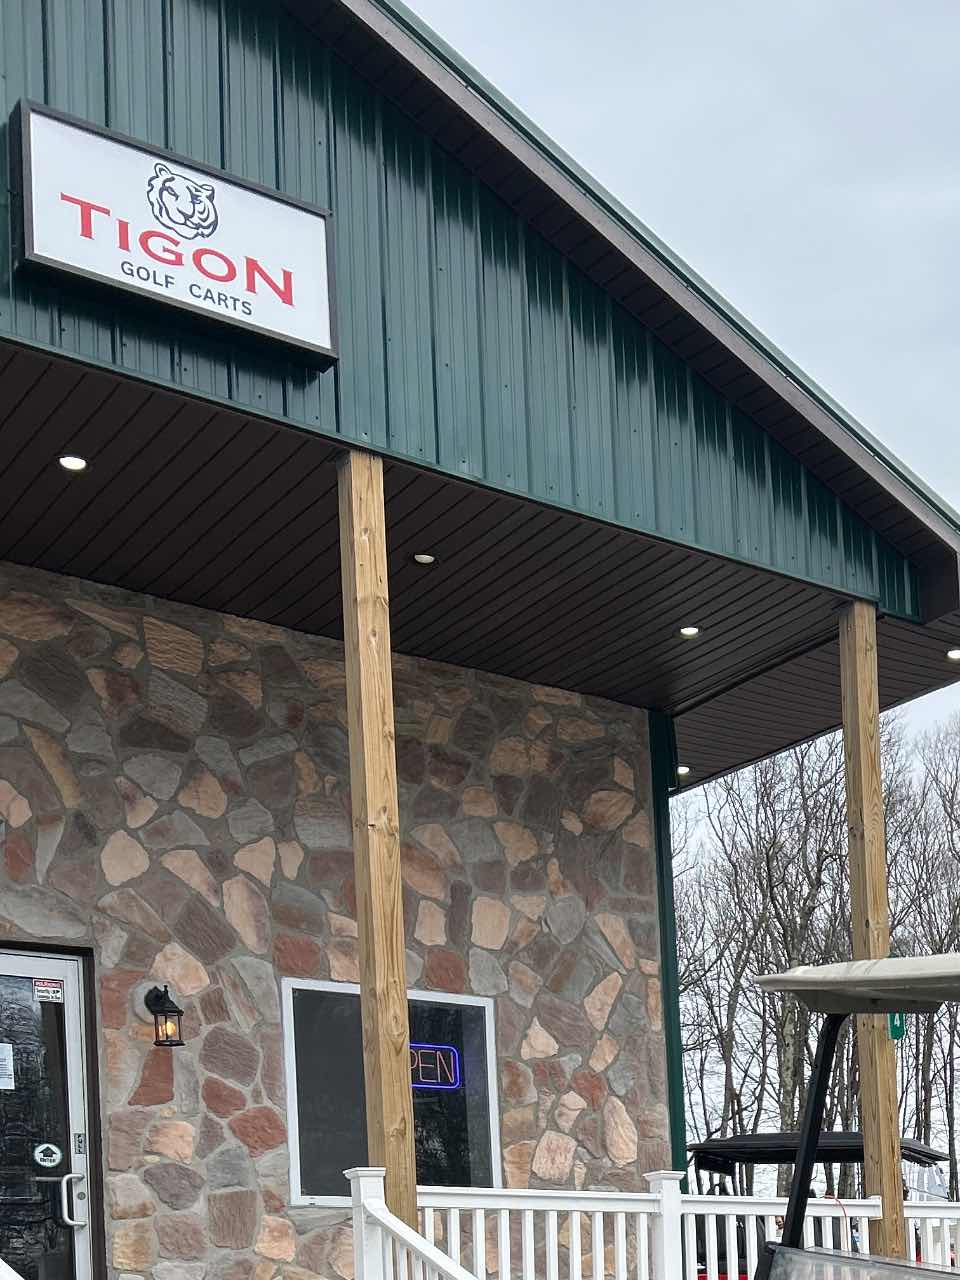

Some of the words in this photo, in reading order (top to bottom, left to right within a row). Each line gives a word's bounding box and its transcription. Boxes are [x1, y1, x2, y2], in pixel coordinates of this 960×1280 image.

[60, 192, 294, 307] TIGON
[120, 261, 175, 289] GOLF
[189, 283, 253, 316] CARTS
[409, 1049, 454, 1084] PEN
